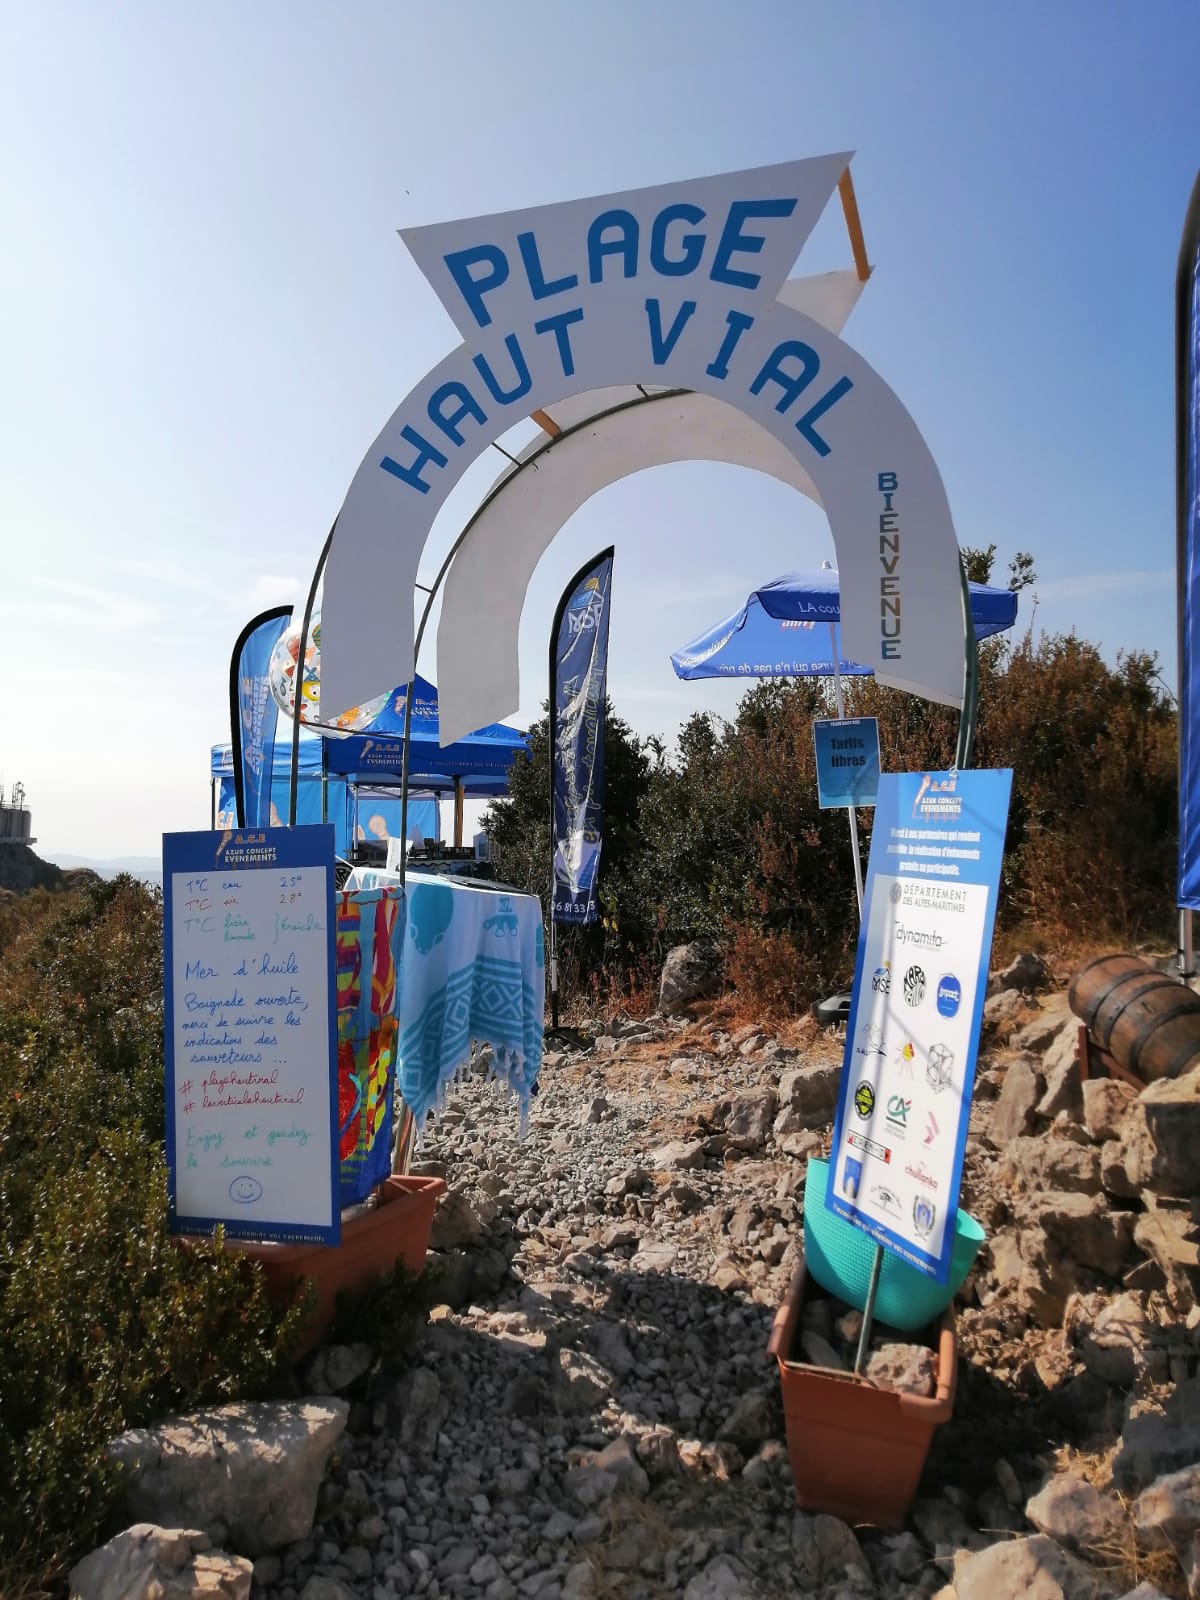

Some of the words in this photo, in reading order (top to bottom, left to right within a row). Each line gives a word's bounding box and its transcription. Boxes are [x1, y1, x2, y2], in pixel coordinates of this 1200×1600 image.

[443, 198, 799, 328] PLAGE
[379, 308, 584, 495] HAUT
[644, 298, 855, 458] VIAL
[877, 472, 902, 660] BIENVENUE
[798, 601, 818, 613] LA
[818, 605, 840, 614] cou
[830, 736, 864, 750] Tarifs
[831, 755, 866, 768] libres
[224, 853, 277, 863] EVENEMENTS
[904, 884, 968, 901] DÉPARTEMENT
[185, 960, 219, 980] Mer
[184, 987, 245, 1016] Baignade
[182, 1017, 208, 1030] merci
[235, 1015, 274, 1026] suivre
[284, 1011, 301, 1026] les
[254, 1029, 278, 1045] des
[243, 1124, 260, 1140] et
